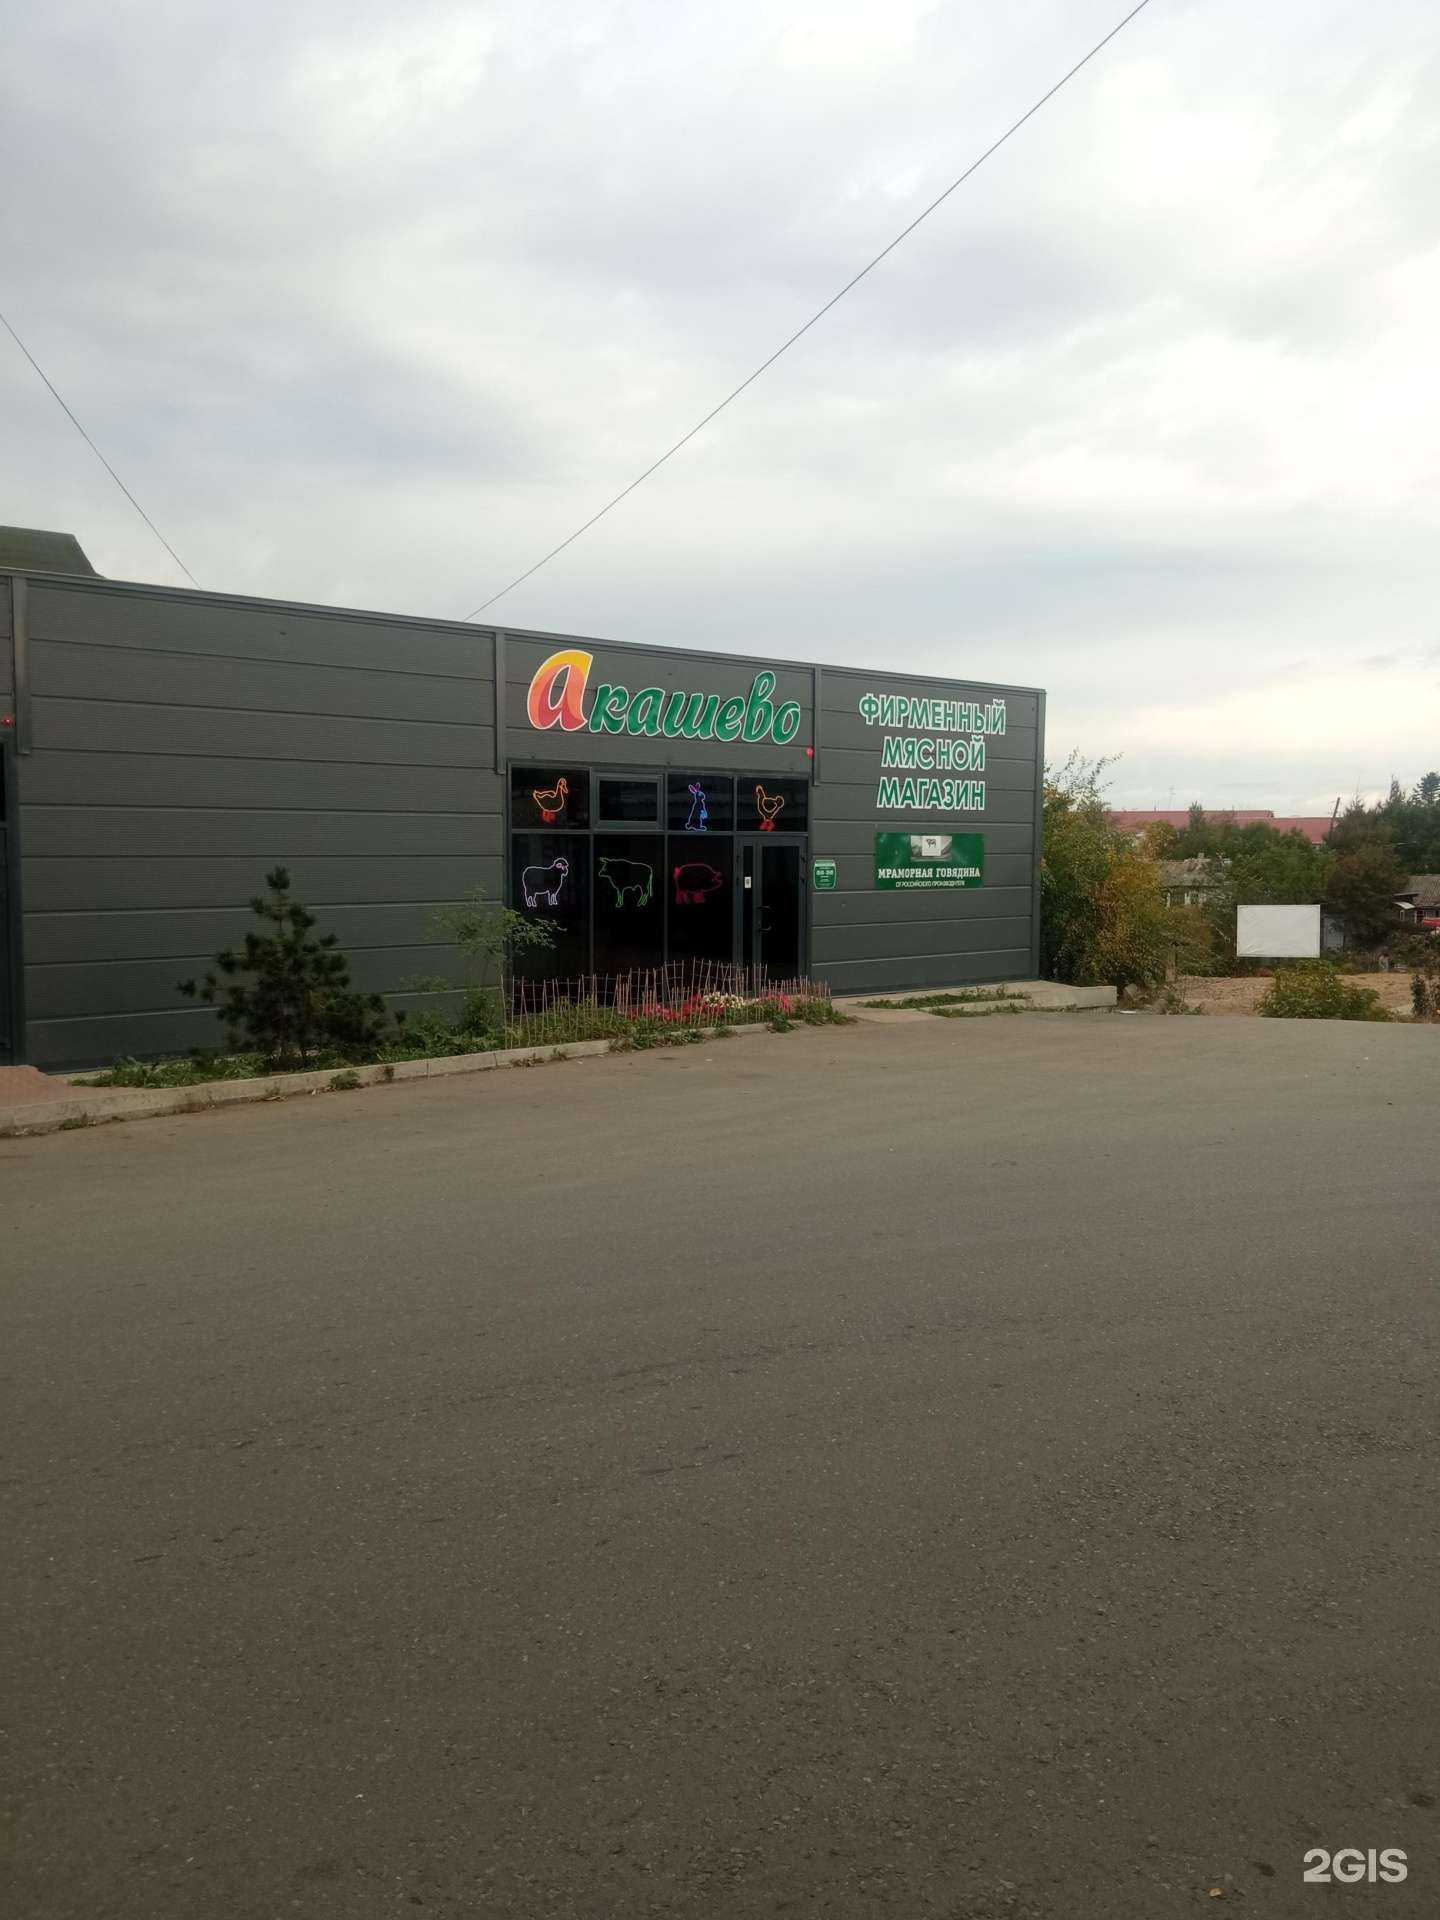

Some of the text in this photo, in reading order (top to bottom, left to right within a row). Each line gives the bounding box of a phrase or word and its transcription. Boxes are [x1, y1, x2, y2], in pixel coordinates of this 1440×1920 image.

[527, 649, 801, 745] Акашево
[859, 693, 1006, 735] ФИРМЕННЫЙ
[881, 735, 985, 771] МЯСНОЙ
[877, 777, 985, 811] МАГАЗИН
[878, 867, 980, 879] МРАМОРНАЯ ГОВЯДИНА
